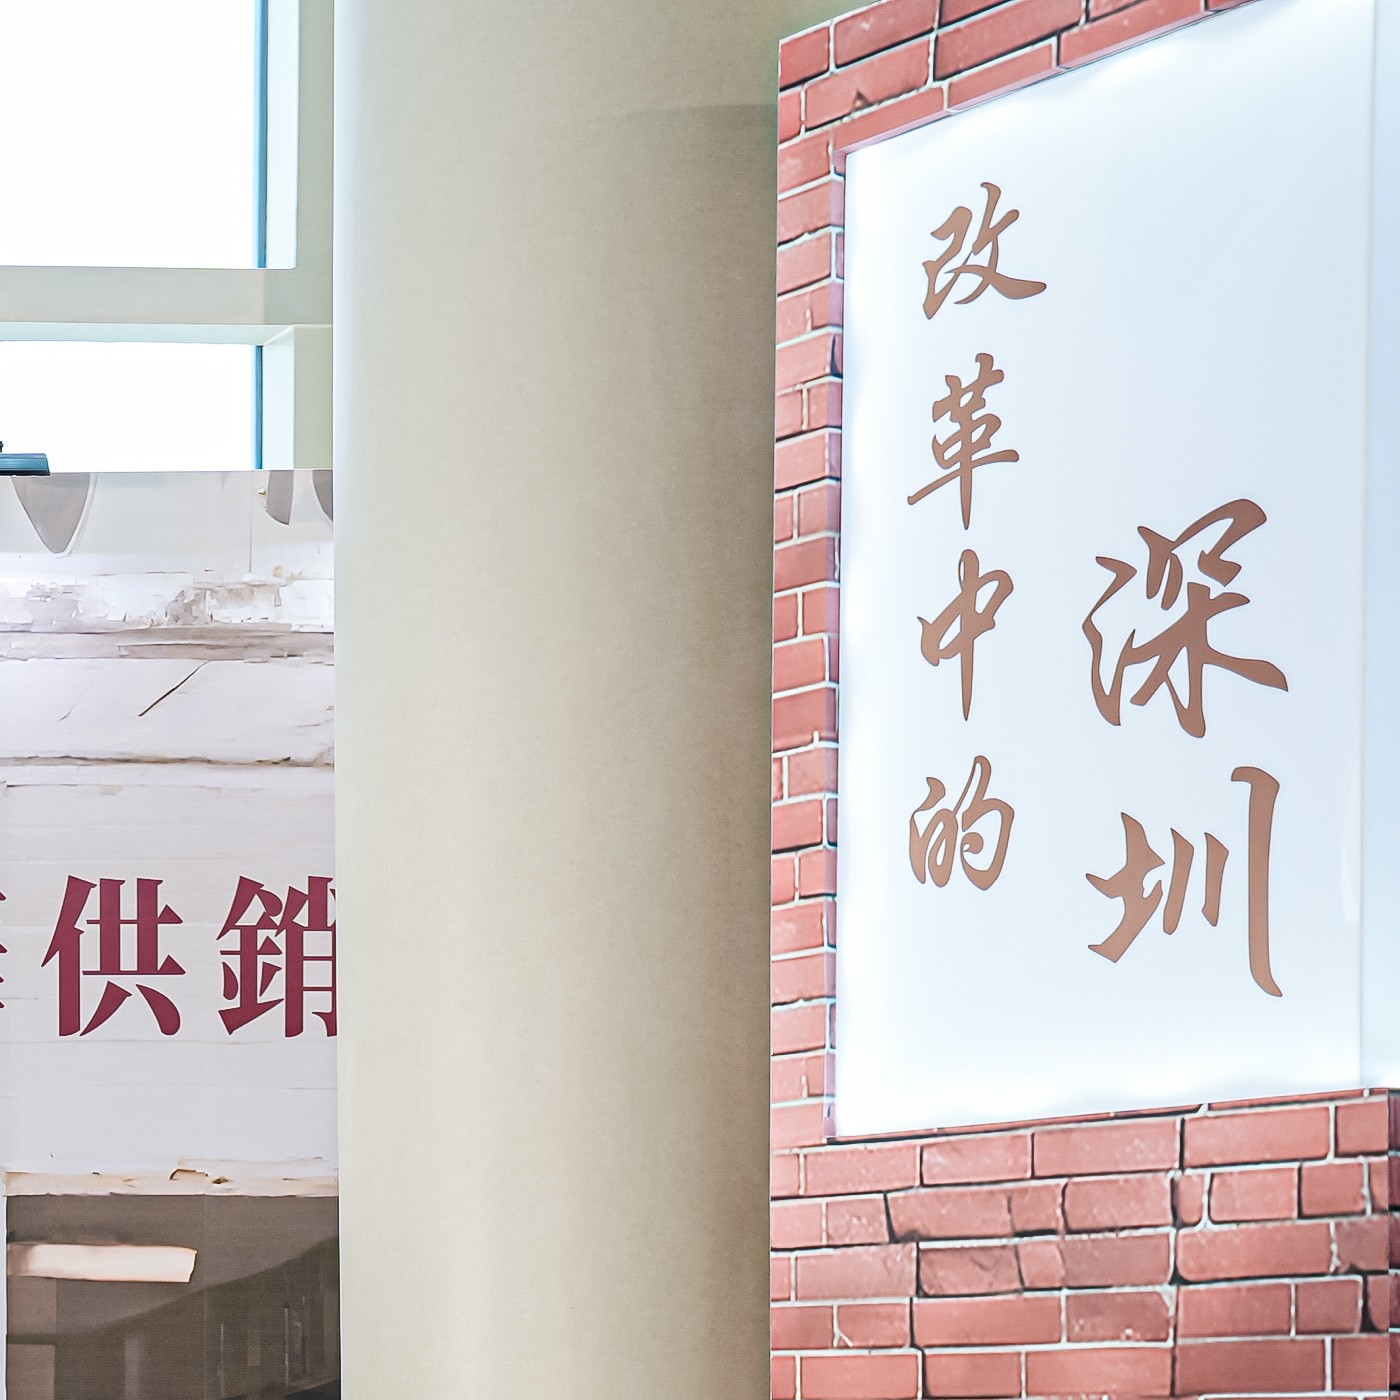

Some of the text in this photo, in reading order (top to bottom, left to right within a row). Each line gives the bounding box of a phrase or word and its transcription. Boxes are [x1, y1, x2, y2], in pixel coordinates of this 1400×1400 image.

[908, 182, 1046, 890] 改革中的
[1082, 498, 1289, 998] 深圳
